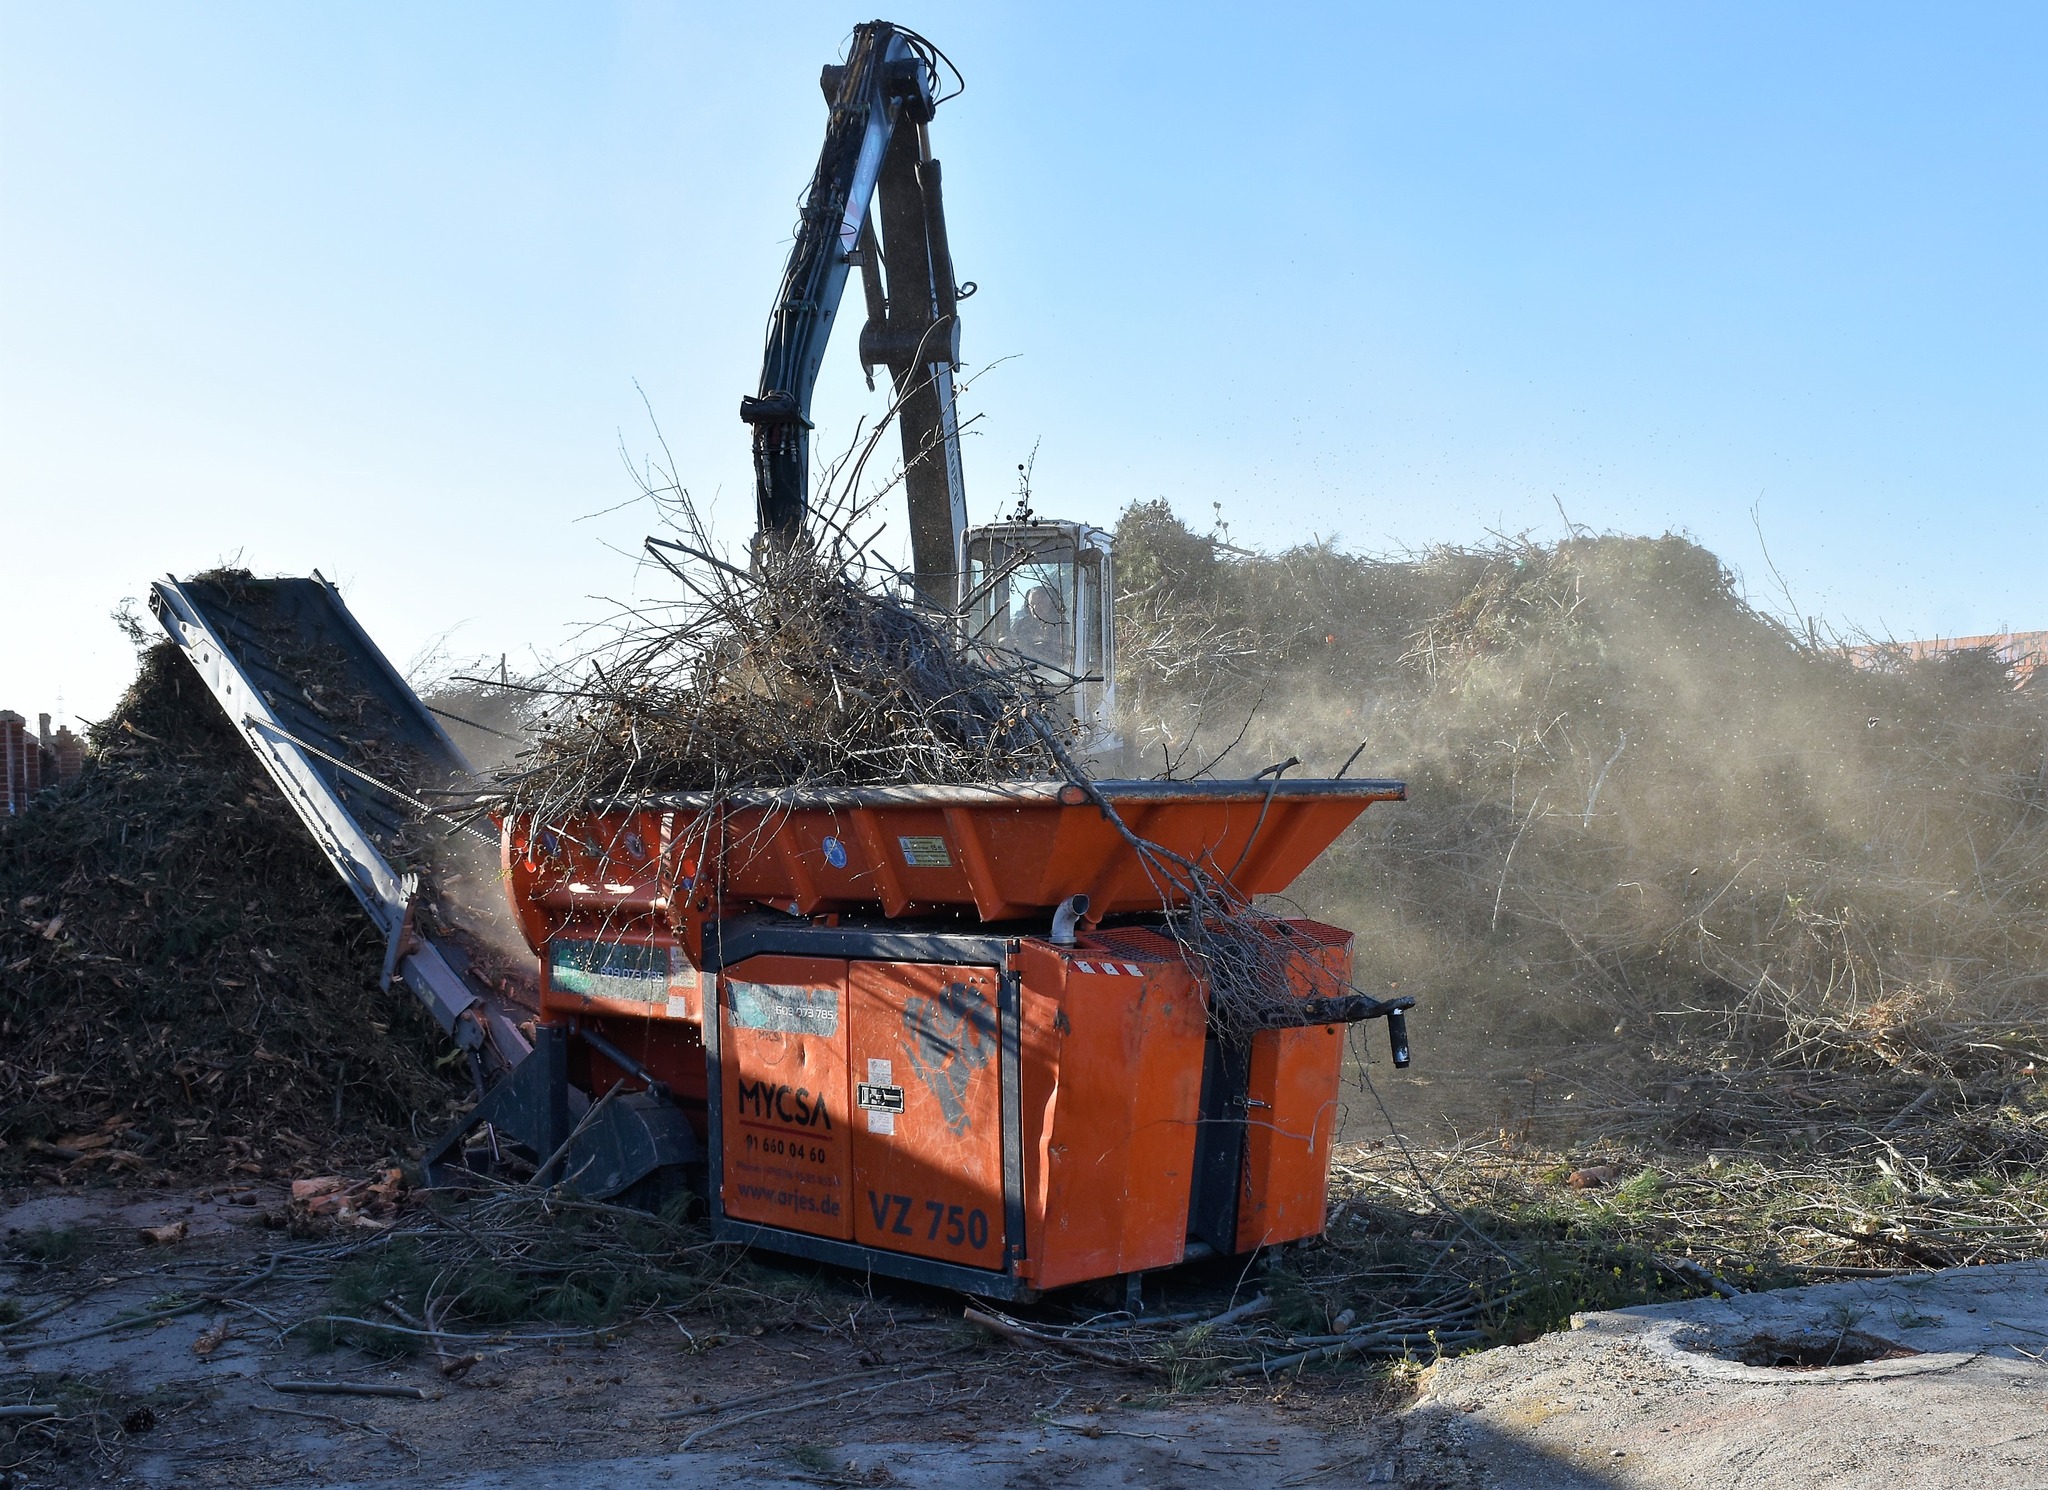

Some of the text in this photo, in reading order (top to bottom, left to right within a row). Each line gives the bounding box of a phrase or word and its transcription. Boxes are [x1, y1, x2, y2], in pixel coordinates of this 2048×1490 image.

[601, 967, 620, 978] 609
[622, 969, 641, 981] 073
[796, 1007, 814, 1018] 073
[816, 1008, 834, 1020] 785
[738, 1078, 833, 1130] MYCSA
[763, 1137, 784, 1155] 660
[789, 1142, 805, 1160] 04
[810, 1147, 825, 1164] 60
[738, 1183, 841, 1217] www.arjes.de
[867, 1190, 989, 1250] VZ 750
